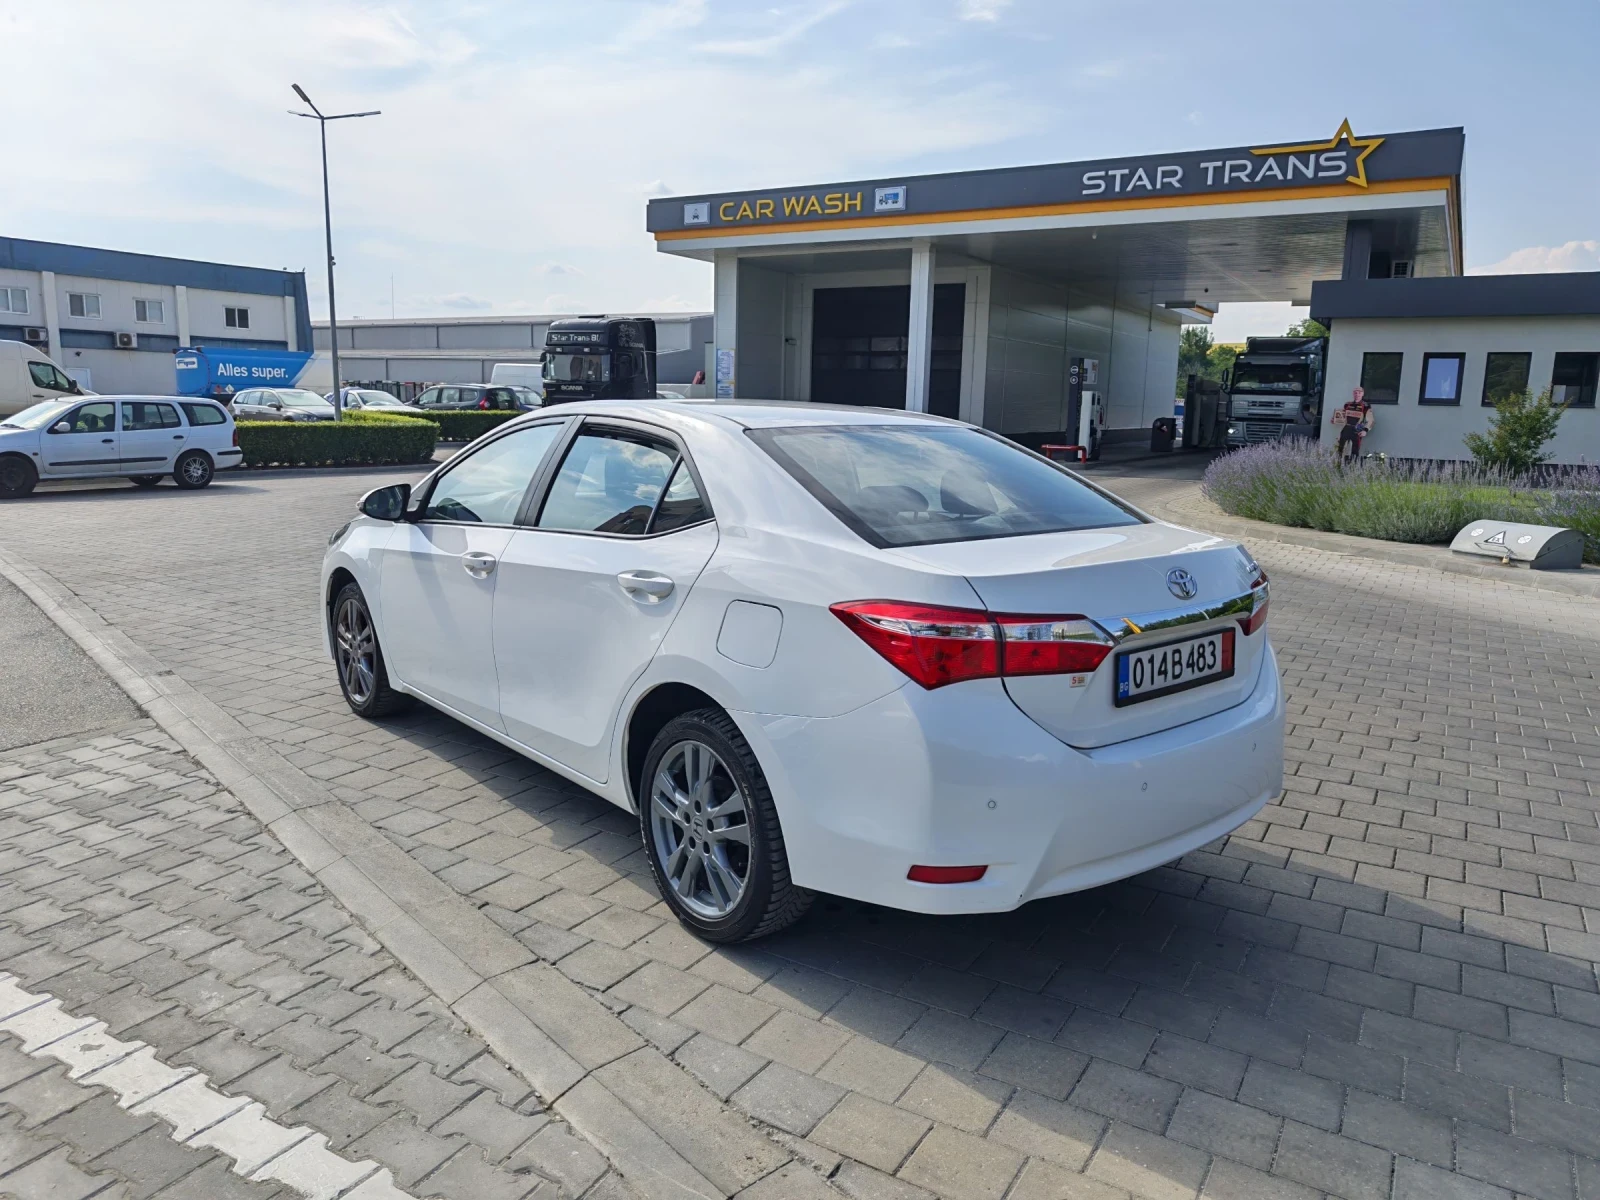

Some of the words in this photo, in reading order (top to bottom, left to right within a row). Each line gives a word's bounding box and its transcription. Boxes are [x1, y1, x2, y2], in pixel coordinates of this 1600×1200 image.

[1082, 165, 1184, 196] STAR
[1200, 150, 1347, 186] TRANS
[719, 199, 776, 221] CAR
[782, 191, 863, 217] WASH
[217, 362, 249, 377] Alles
[251, 366, 289, 380] super.
[1119, 682, 1129, 692] BG
